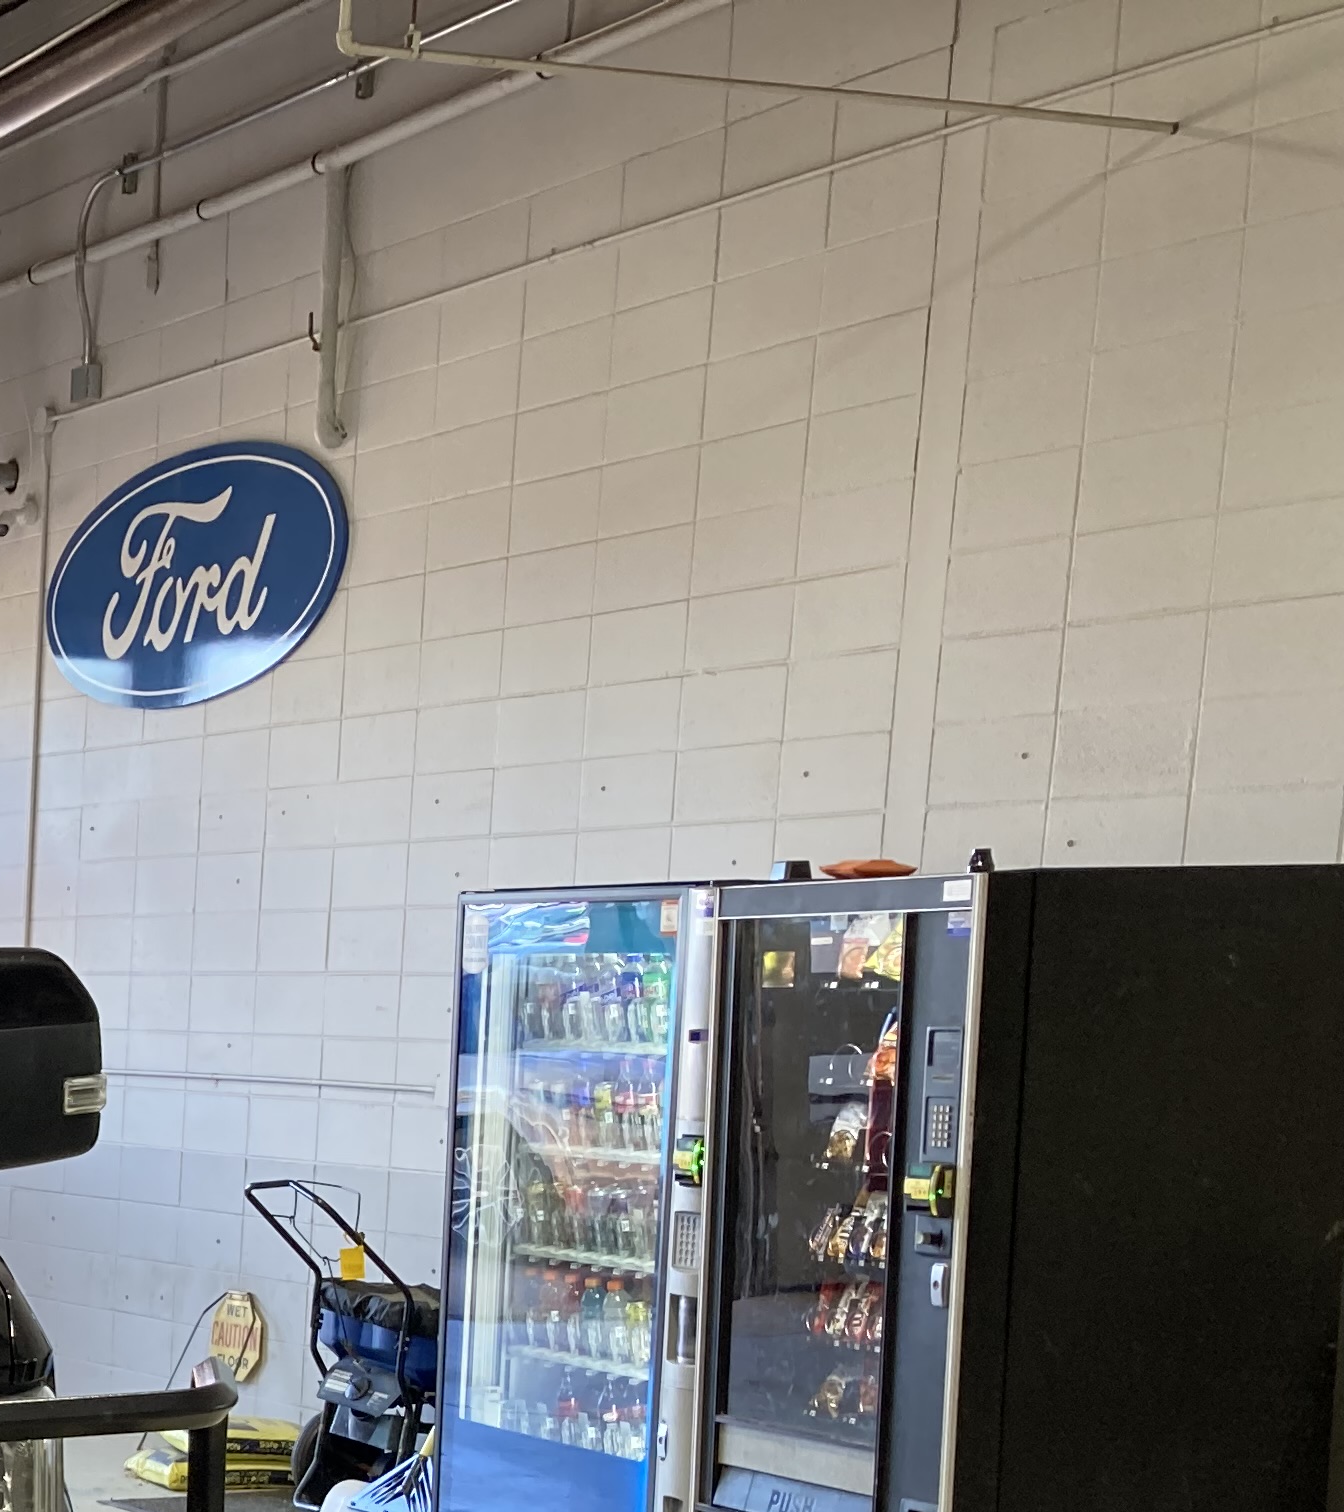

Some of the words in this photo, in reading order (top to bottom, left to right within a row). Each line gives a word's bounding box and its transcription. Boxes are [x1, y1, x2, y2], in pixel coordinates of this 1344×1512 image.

[102, 485, 276, 660] Ford
[227, 1304, 248, 1318] WET
[211, 1321, 259, 1351] CAUTION
